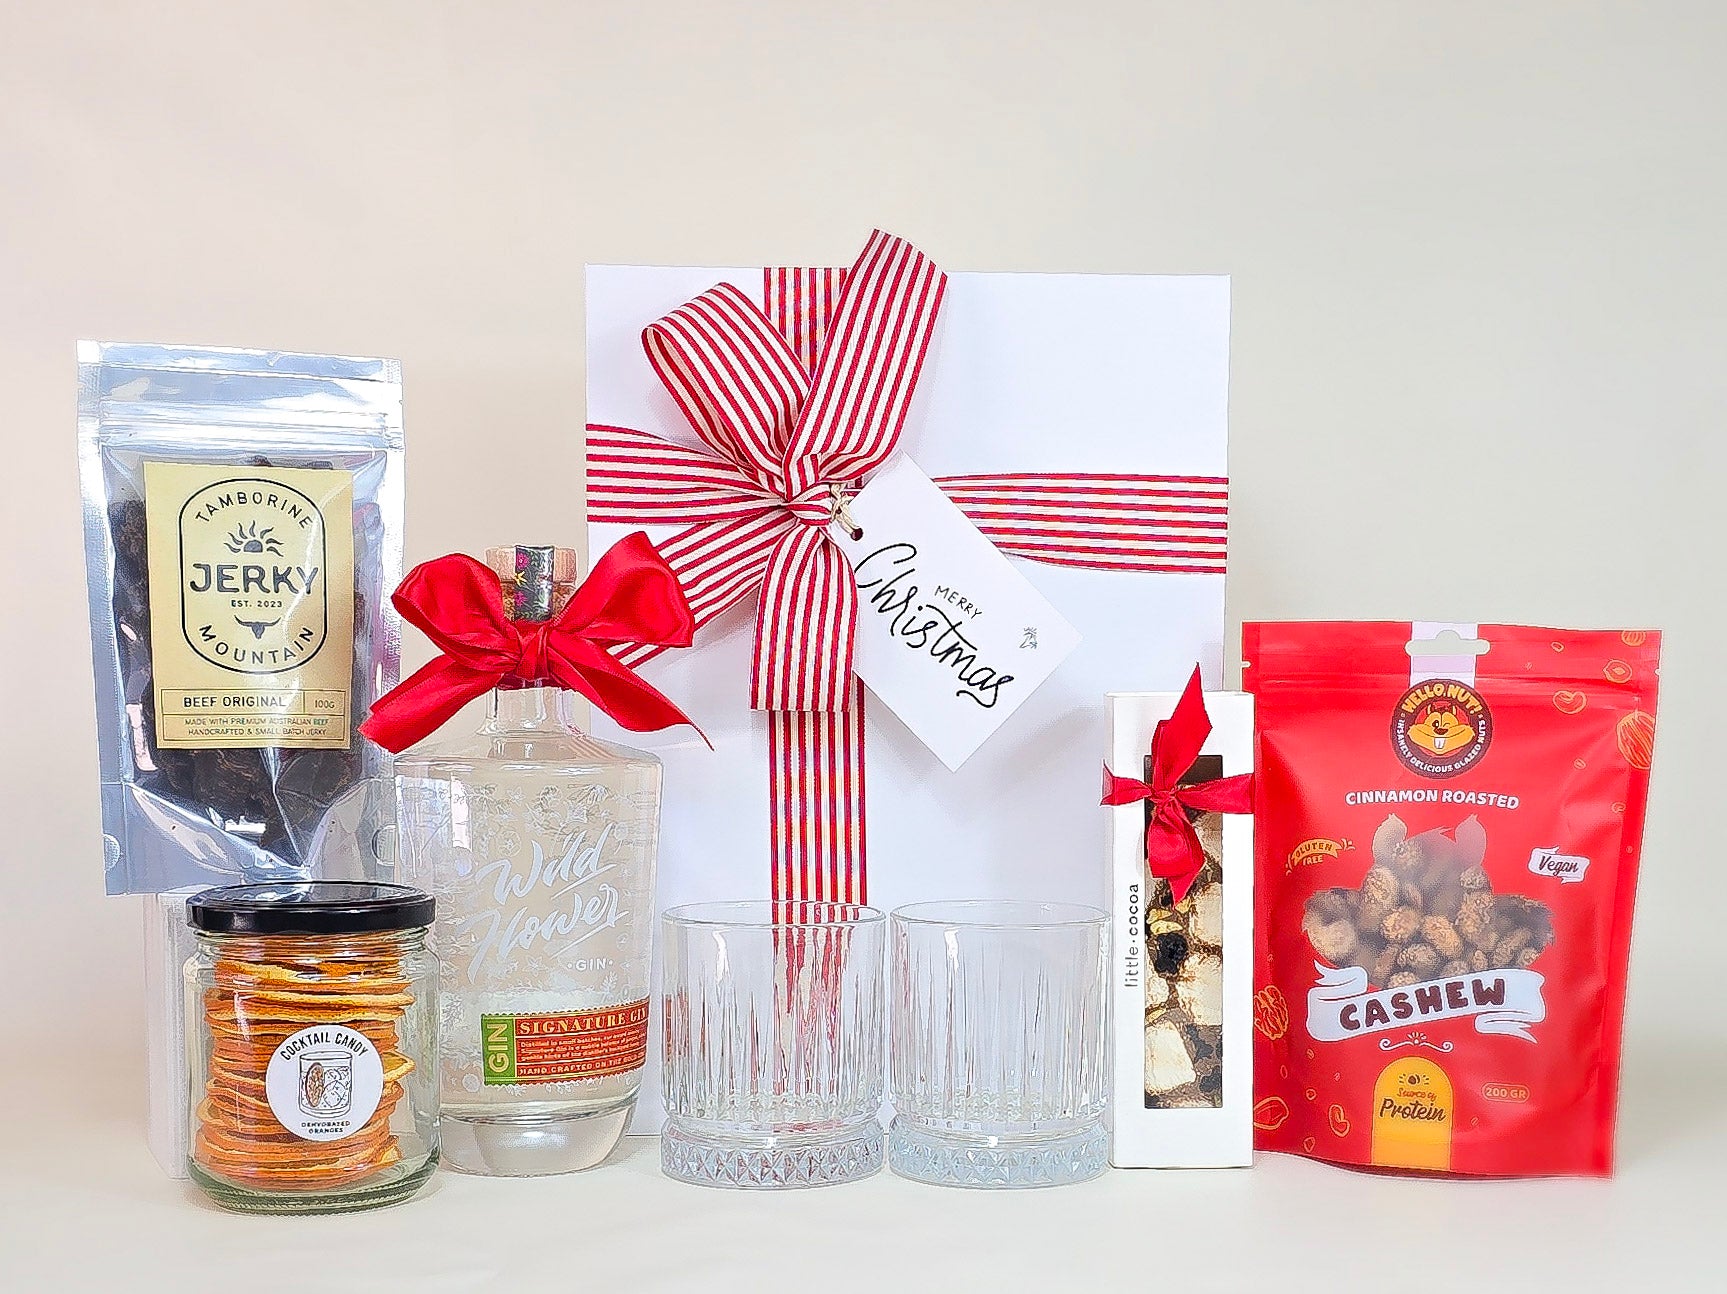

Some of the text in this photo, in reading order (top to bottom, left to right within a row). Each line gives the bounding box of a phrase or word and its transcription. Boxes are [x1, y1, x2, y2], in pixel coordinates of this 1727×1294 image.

[195, 491, 313, 529] TAMBORINE
[189, 563, 319, 595] JERKY
[230, 600, 283, 608] EST. 2023
[934, 585, 983, 620] MERRY
[854, 543, 1014, 708] Christmas
[199, 624, 314, 665] MOUNTAIN
[183, 696, 287, 708] BEEF ORIGINAL
[314, 699, 336, 709] 100G
[1447, 684, 1483, 715] NUT!
[188, 728, 327, 736] HANDCRAFTED & SMALL BATCH JERKY
[230, 717, 267, 725] PREMIUM
[1345, 788, 1520, 810] CINNAMON ROASTED
[474, 822, 617, 905] Wild
[1537, 855, 1580, 876] Vegan
[1339, 978, 1506, 1031] CASHEW
[520, 1012, 626, 1035] SIGNATURE
[280, 1031, 369, 1061] COCKTAIL CANDY
[486, 1023, 510, 1073] GIN
[550, 1062, 593, 1073] CRAFTED
[595, 1061, 607, 1069] ON
[1485, 1086, 1527, 1100] 200 GR
[1379, 1097, 1447, 1121] Protein
[308, 1127, 344, 1135] ORANGES
